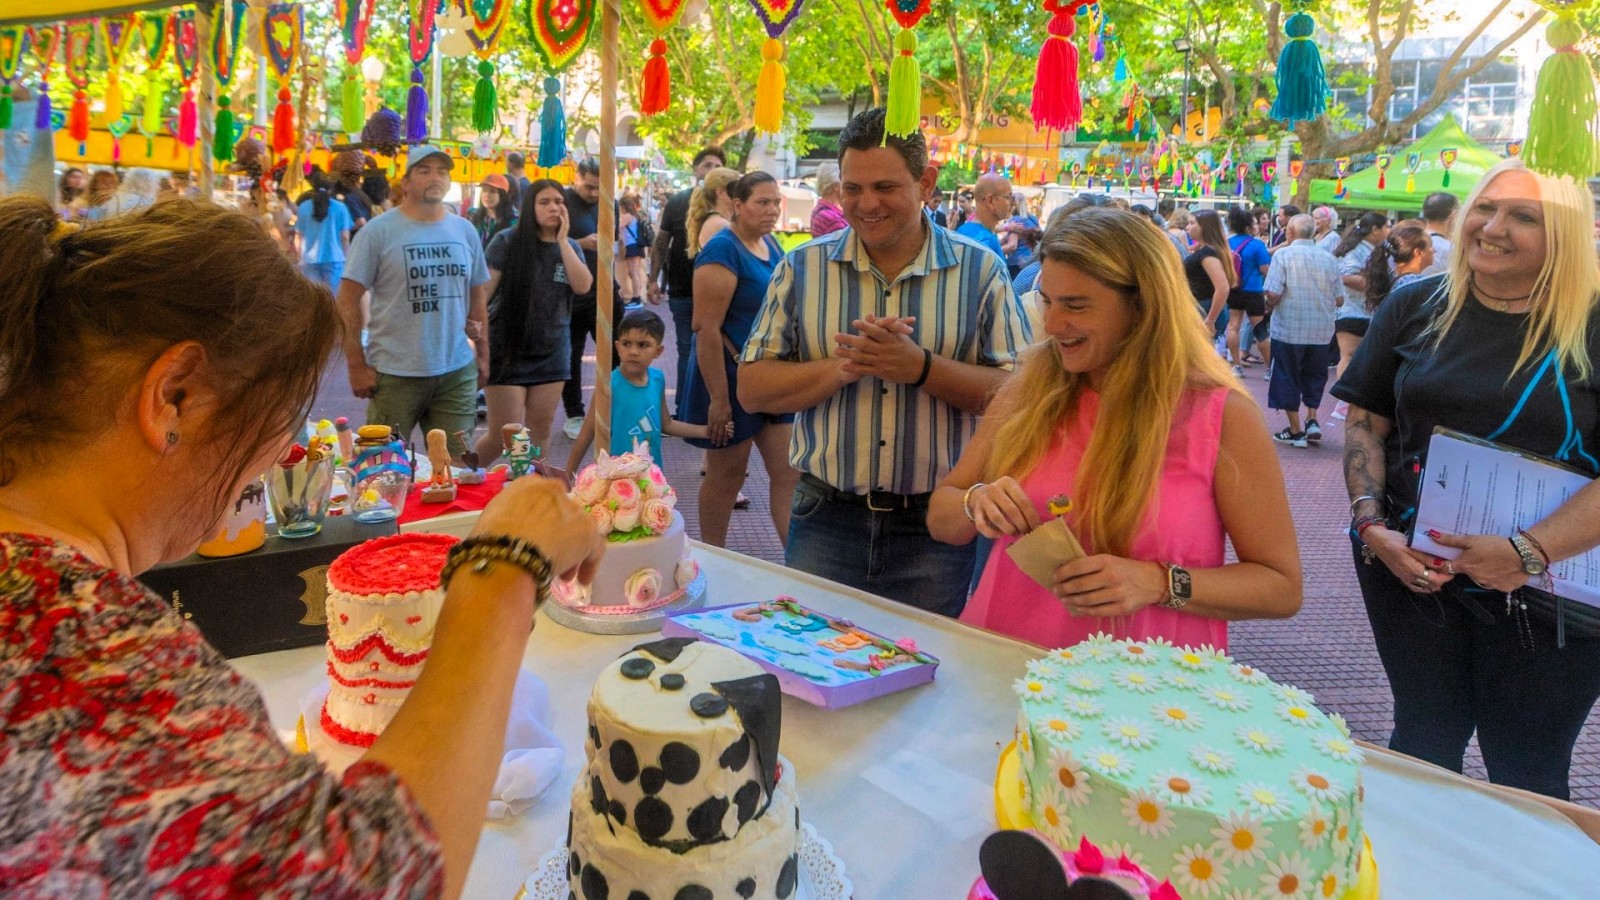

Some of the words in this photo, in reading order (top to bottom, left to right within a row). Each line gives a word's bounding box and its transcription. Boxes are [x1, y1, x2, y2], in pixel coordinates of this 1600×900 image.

[407, 247, 451, 260] THINK
[410, 264, 466, 279] OUTSIDE
[410, 284, 437, 298] THE
[412, 300, 439, 314] BOX
